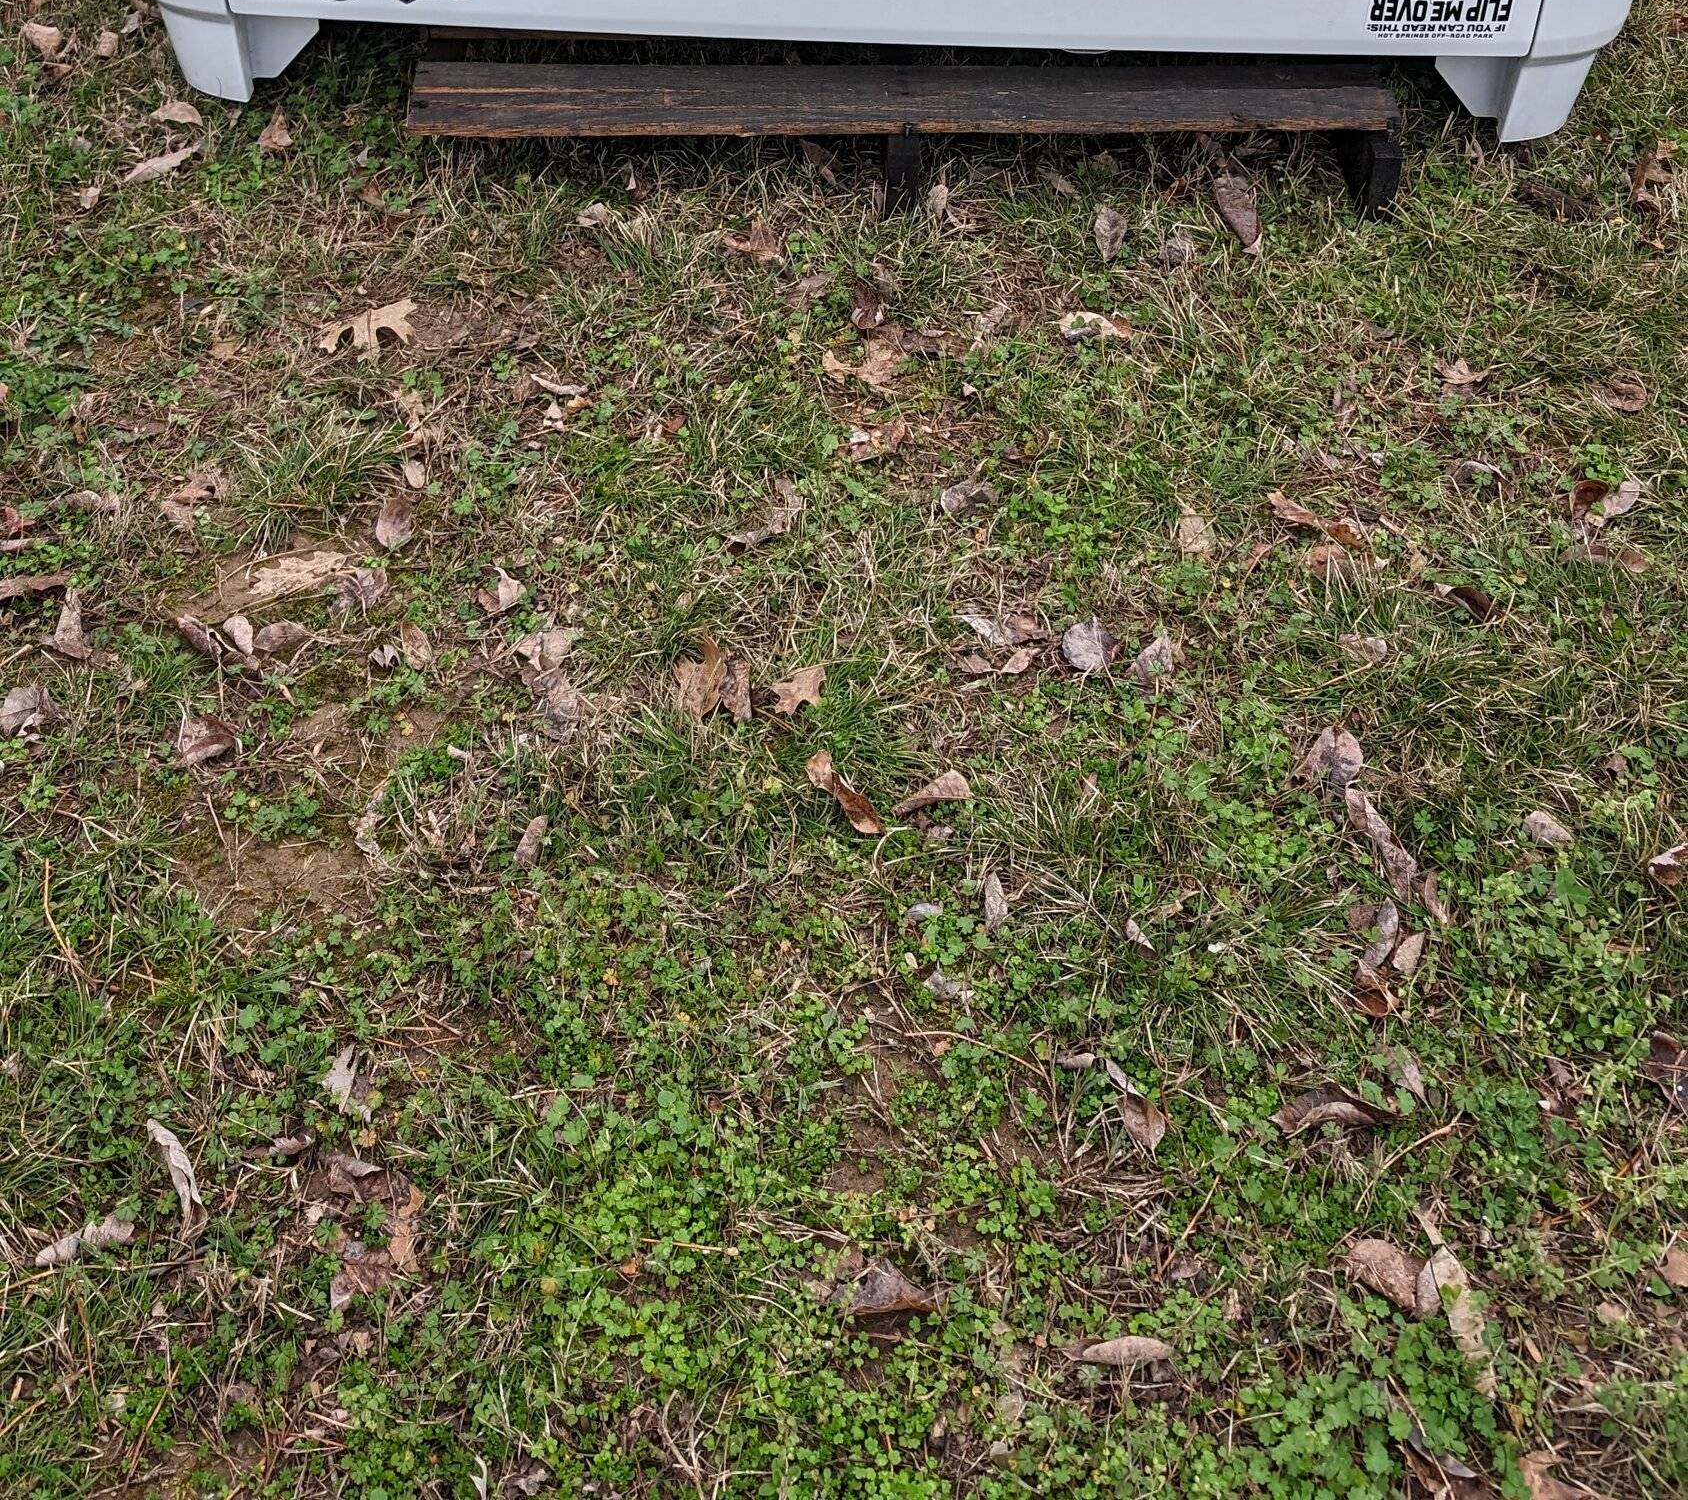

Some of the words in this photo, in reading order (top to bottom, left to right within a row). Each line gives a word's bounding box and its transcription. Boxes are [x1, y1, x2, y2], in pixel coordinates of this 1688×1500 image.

[1430, 0, 1464, 22] ME
[1367, 24, 1399, 32] THIS:
[1402, 24, 1437, 32] READ
[1438, 24, 1464, 32] CAN
[1467, 24, 1492, 32] YOU
[1495, 24, 1506, 32] IF
